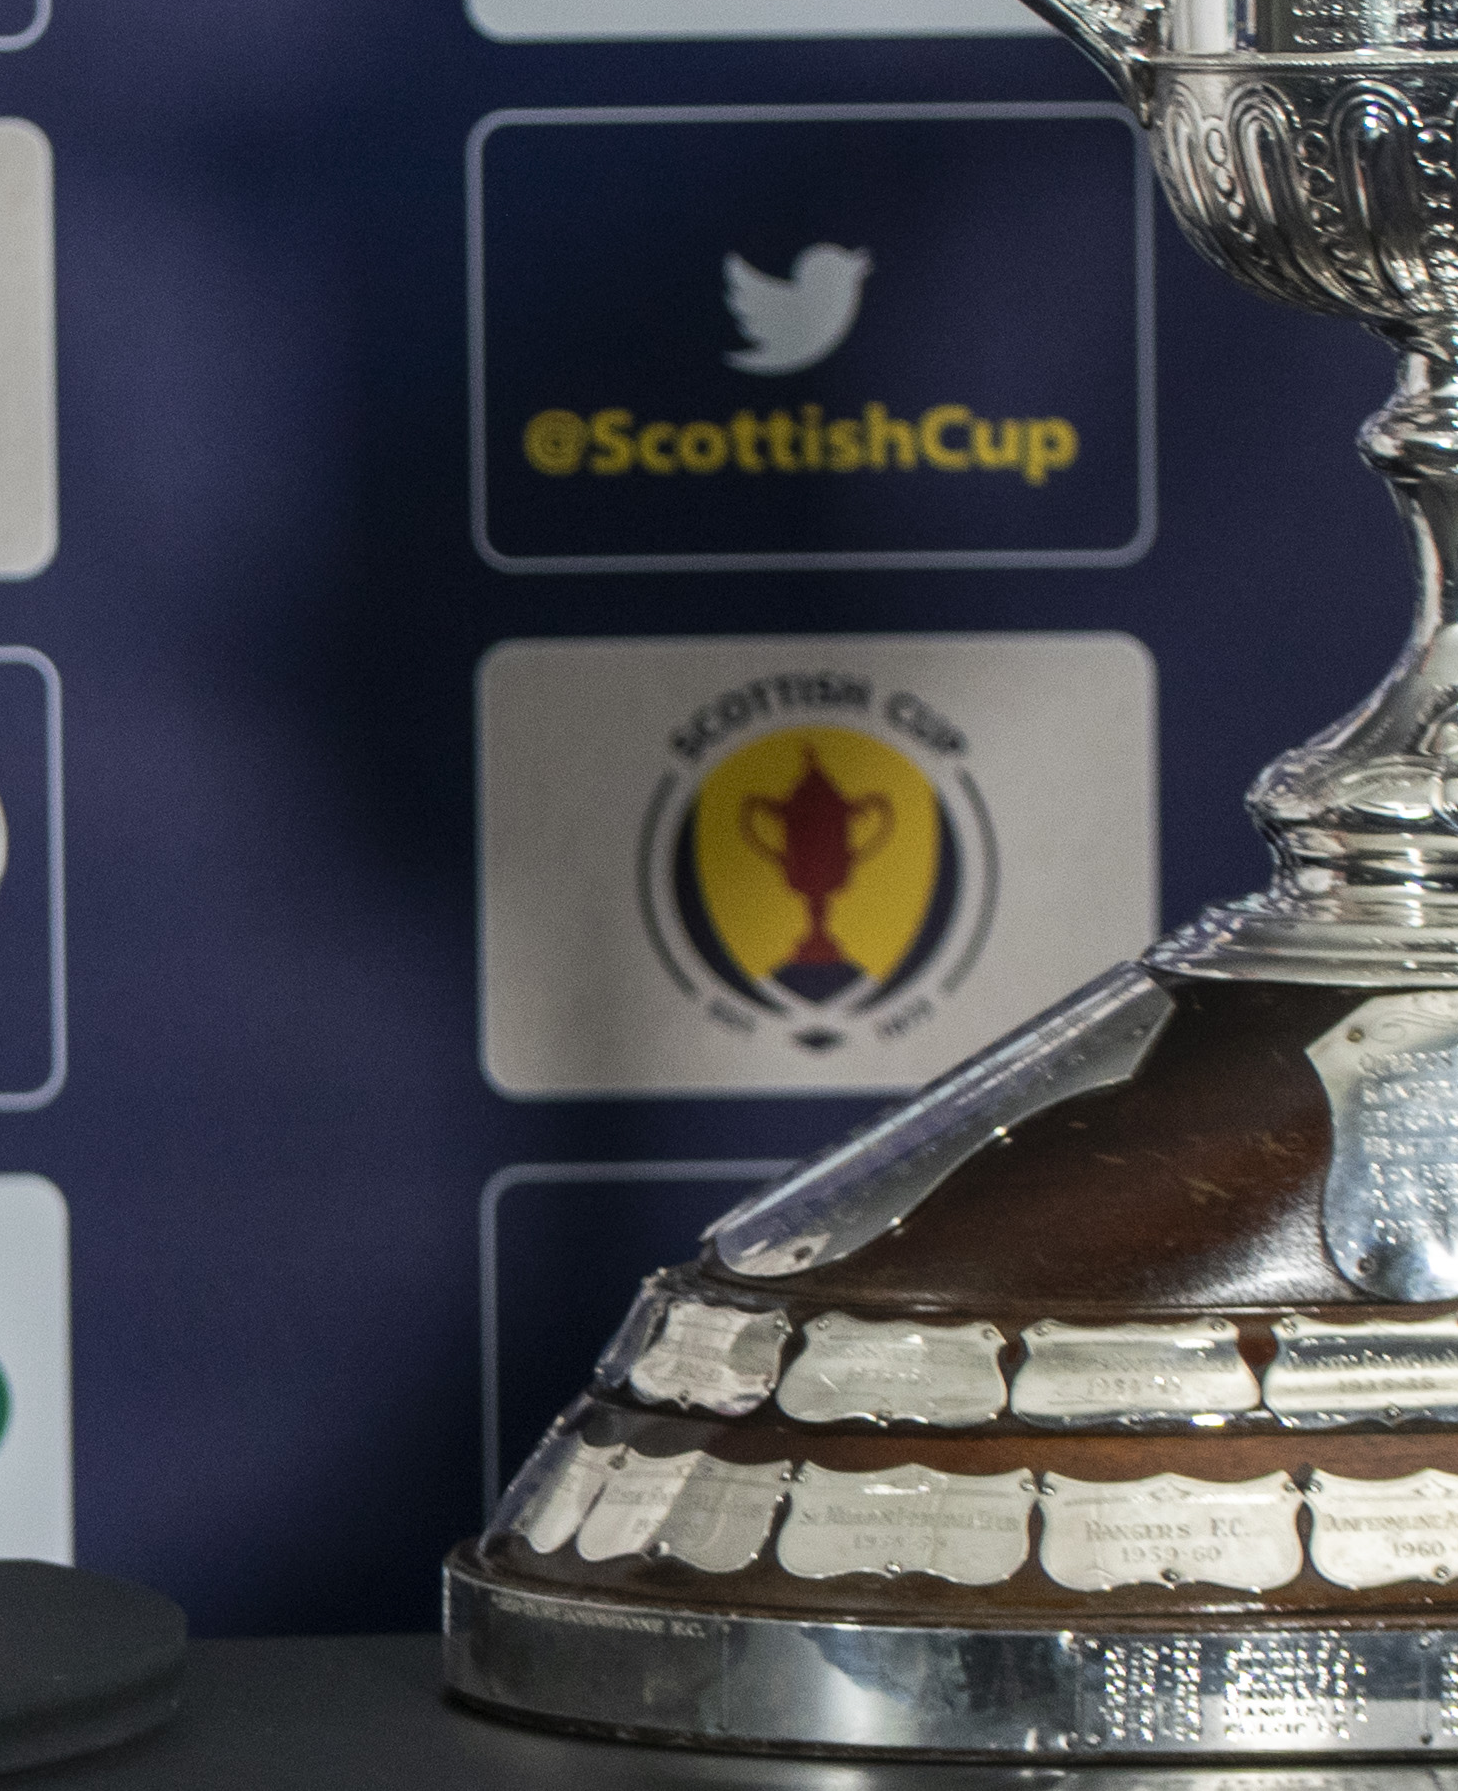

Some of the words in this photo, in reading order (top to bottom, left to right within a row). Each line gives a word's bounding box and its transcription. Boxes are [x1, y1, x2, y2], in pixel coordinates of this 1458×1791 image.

[524, 401, 1079, 485] @ScottishCup
[669, 669, 873, 764] SCOTTISH
[884, 690, 968, 757] CUP
[1083, 1519, 1194, 1543] RANGERS
[1120, 1544, 1224, 1564] 1959-60
